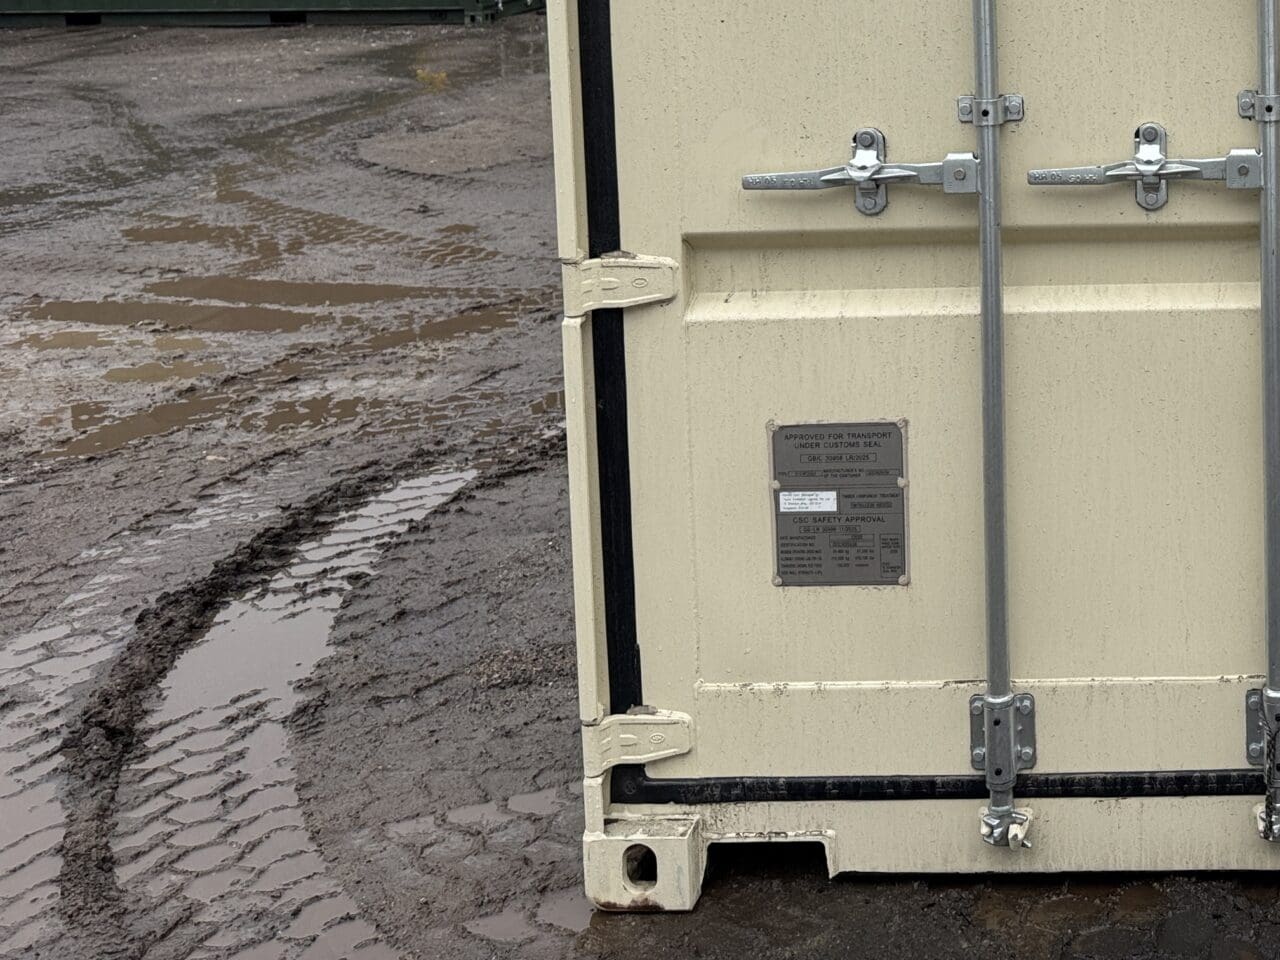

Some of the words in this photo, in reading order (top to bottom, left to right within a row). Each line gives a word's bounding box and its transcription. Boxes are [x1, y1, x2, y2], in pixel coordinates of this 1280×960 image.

[784, 433, 825, 441] APPROVED
[828, 432, 844, 440] FOR
[847, 431, 892, 439] TRANSPORT
[863, 440, 882, 448] SEAL
[812, 516, 841, 524] SAFETY
[845, 515, 886, 523] APPROVAL
